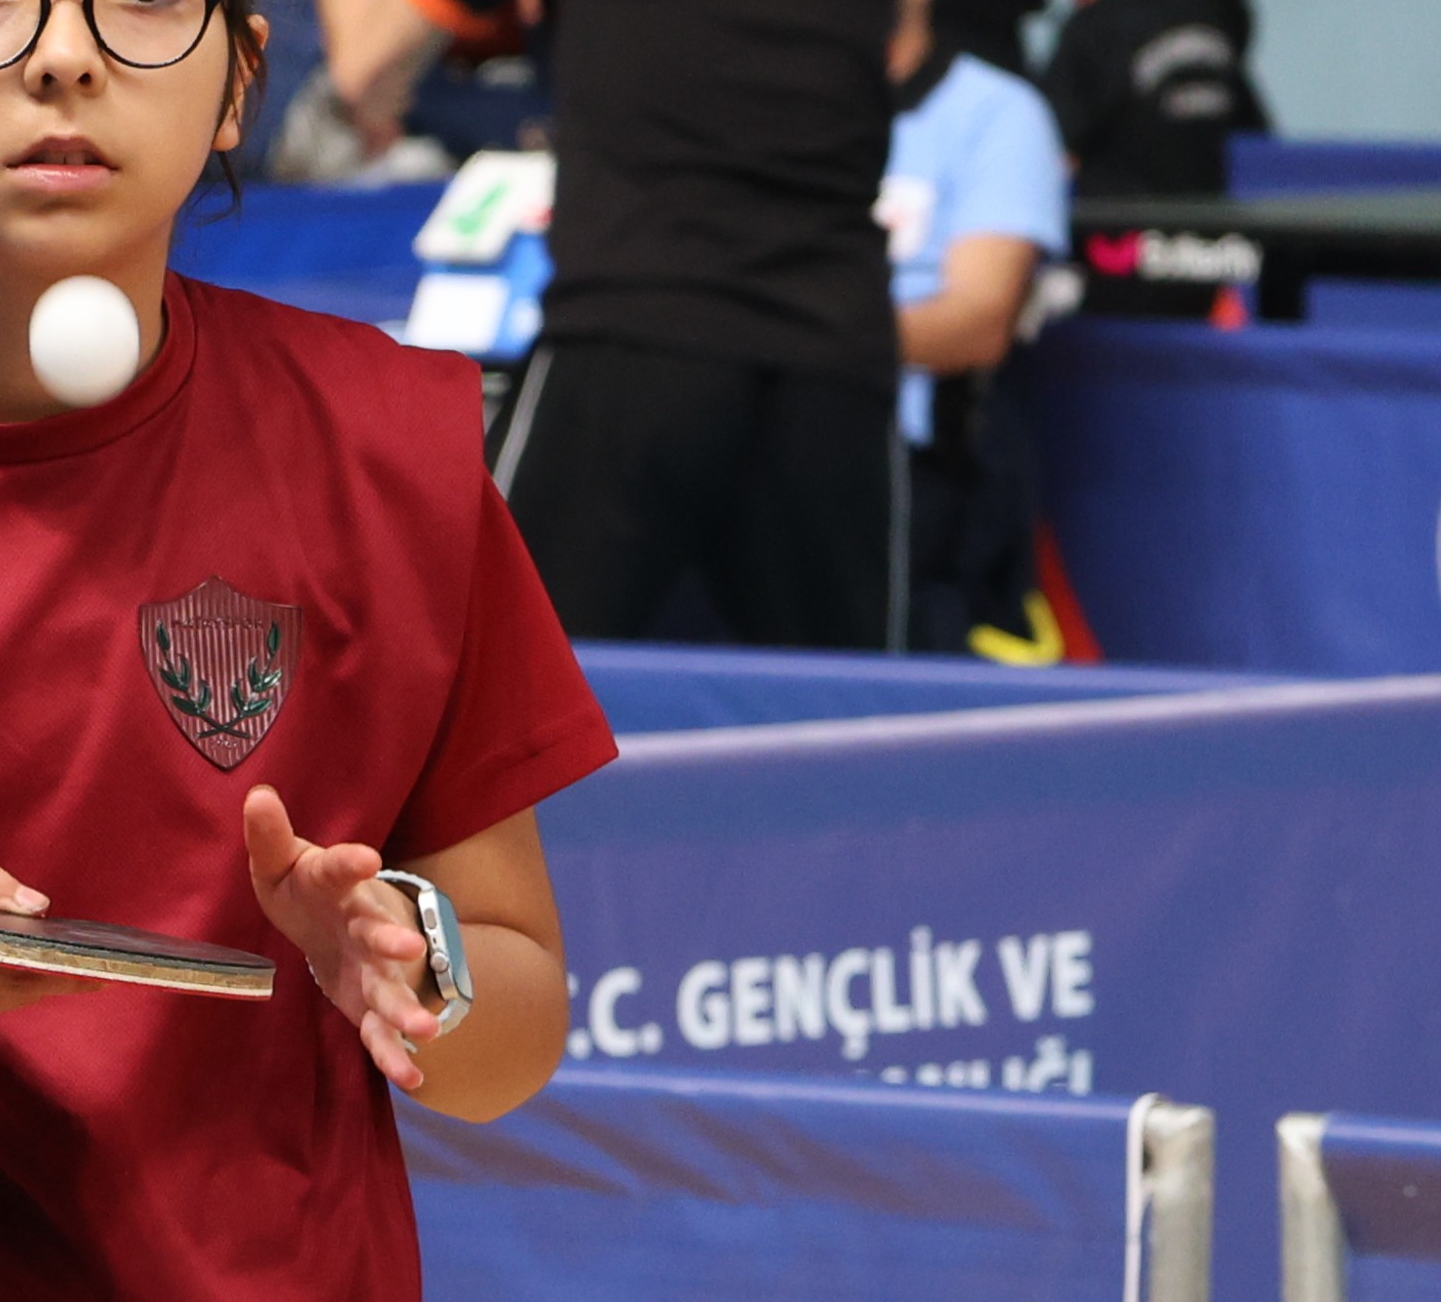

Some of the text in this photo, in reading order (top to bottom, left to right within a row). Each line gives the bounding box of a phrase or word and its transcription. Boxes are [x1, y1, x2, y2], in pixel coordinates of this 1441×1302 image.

[568, 925, 1095, 1061] .C. GENÇLİK VE
